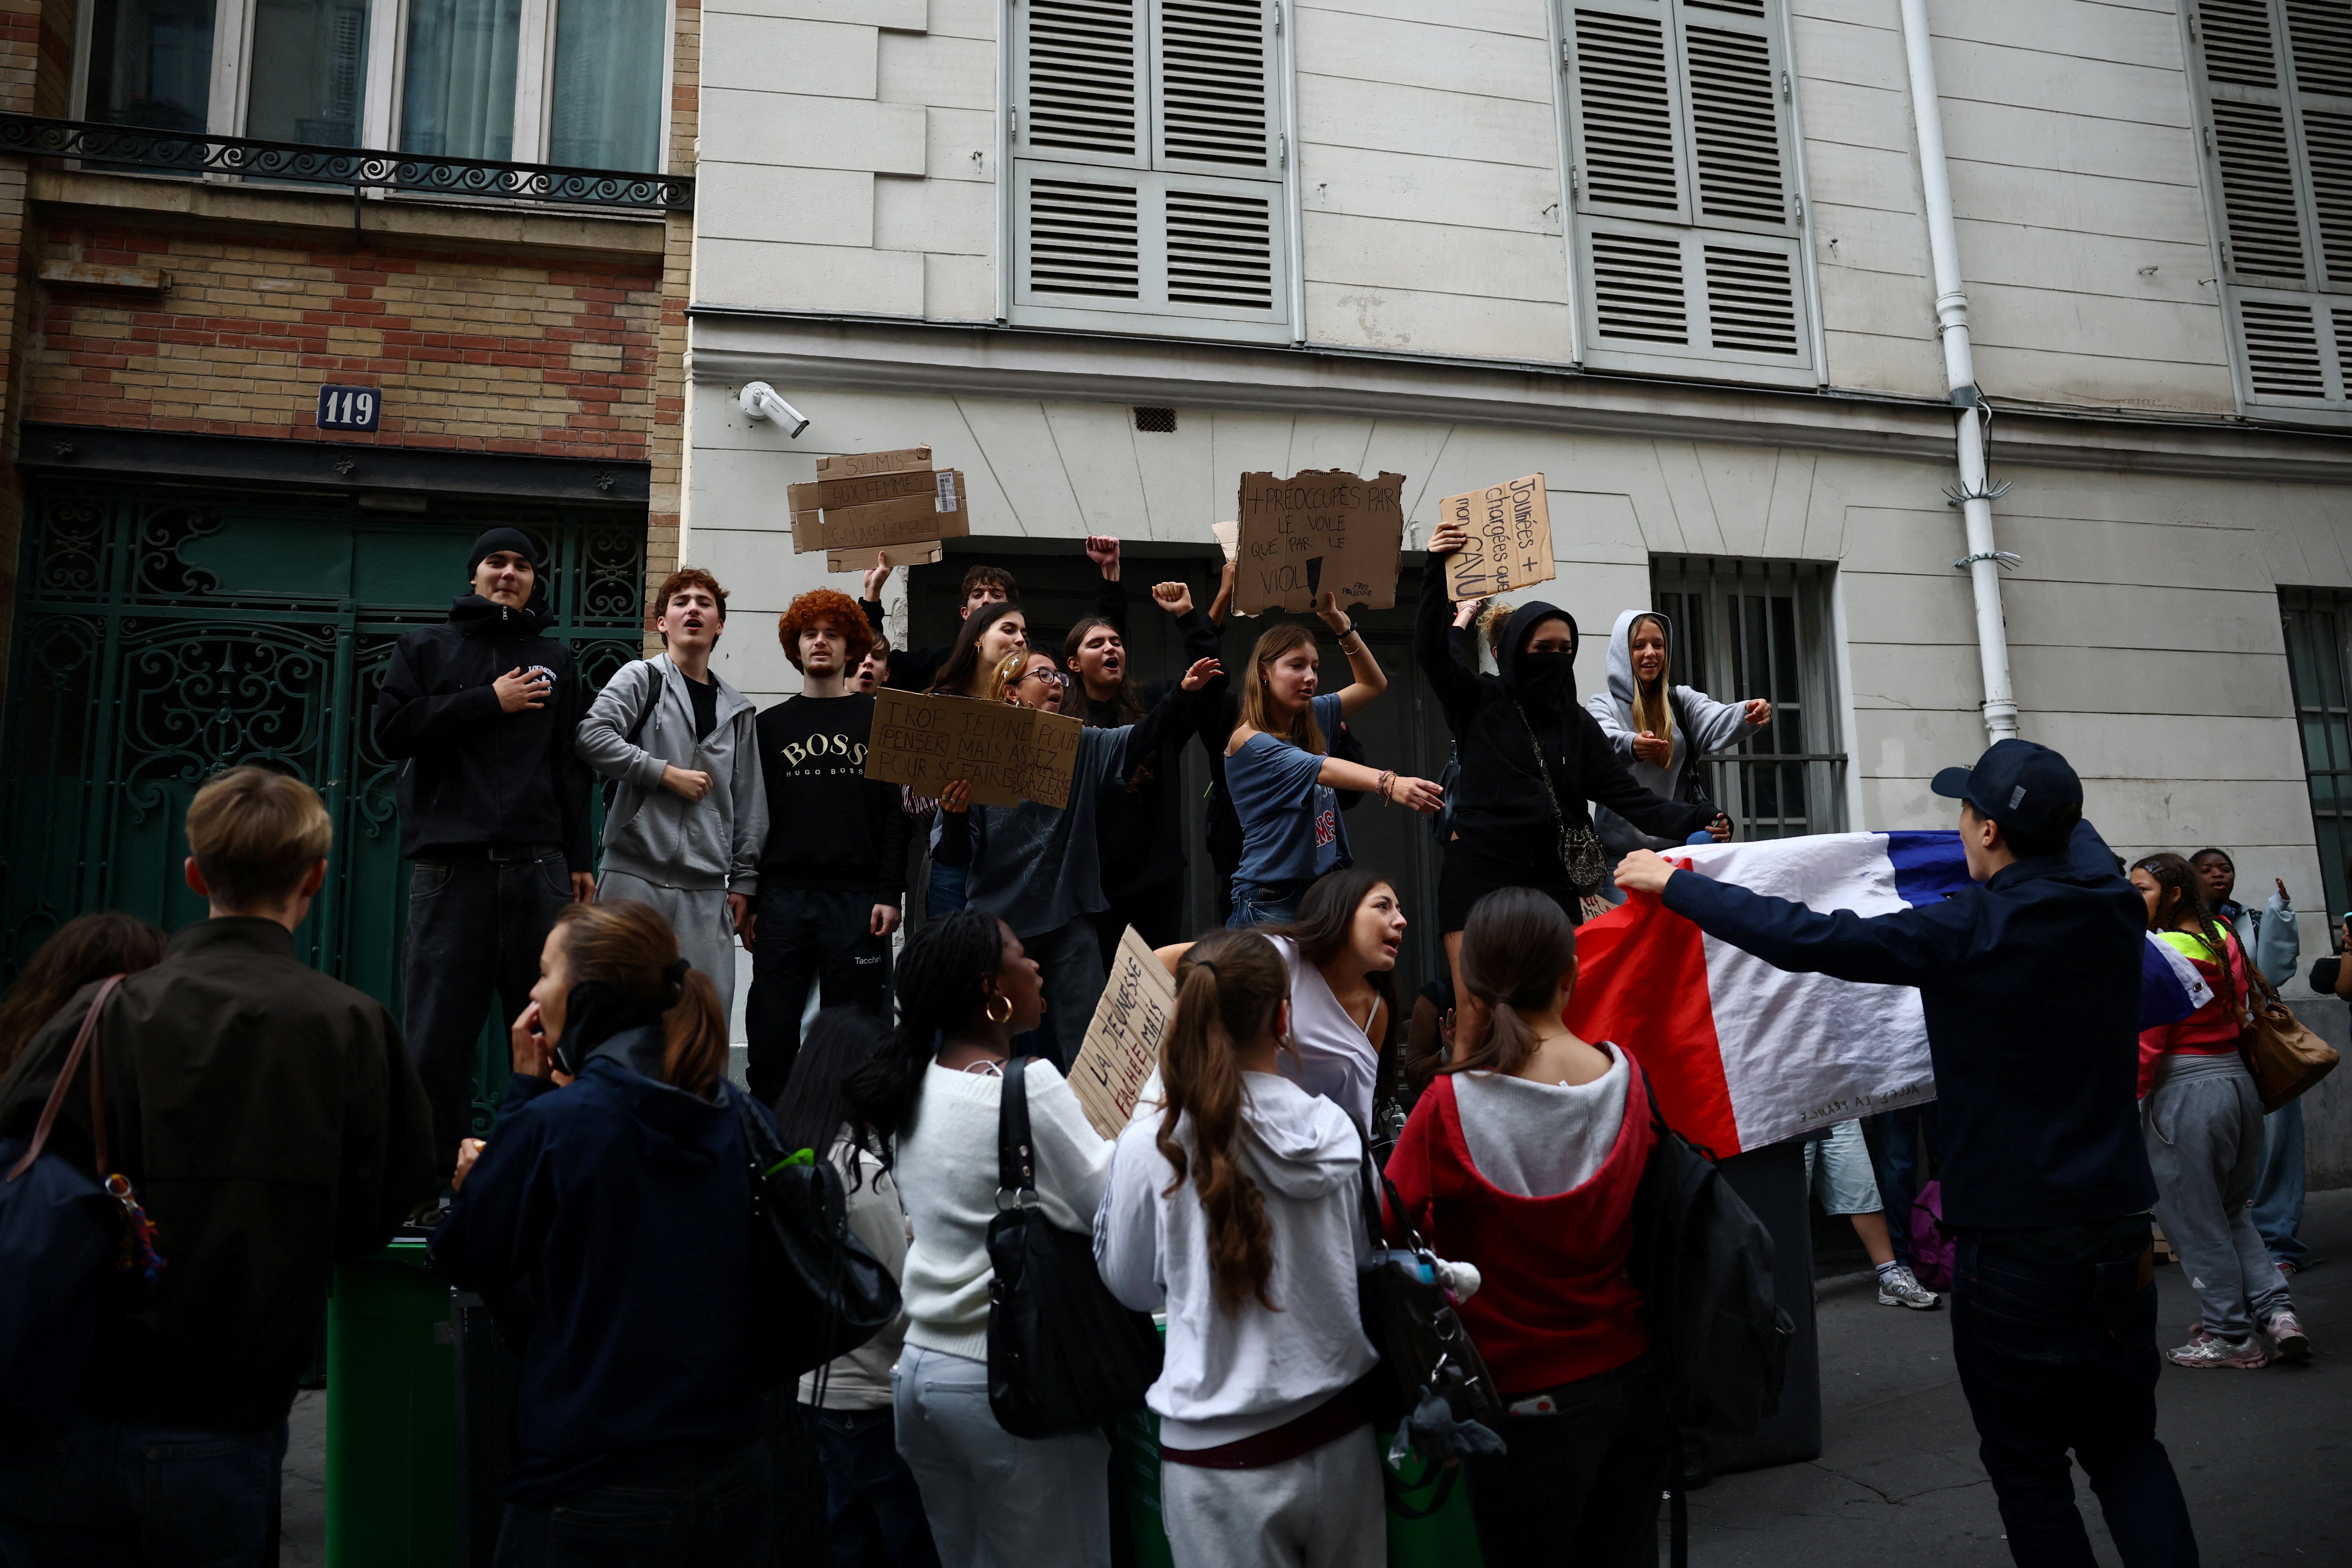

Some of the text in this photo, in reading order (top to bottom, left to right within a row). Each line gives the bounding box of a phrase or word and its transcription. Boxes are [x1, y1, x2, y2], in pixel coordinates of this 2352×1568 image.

[325, 391, 373, 425] 119
[845, 454, 904, 476] SOUMIS
[834, 485, 860, 505] AUX
[865, 475, 923, 498] FEMMES
[1368, 488, 1398, 512] PAR
[848, 504, 896, 524] PAS AU
[1278, 515, 1346, 534] LE VOILE
[1455, 498, 1470, 526] mon
[1251, 537, 1345, 561] QUE PAR LE
[1483, 487, 1511, 592] chargées que
[1353, 582, 1369, 590] FREE
[885, 701, 1080, 751] TROP JEUNE POUR
[781, 733, 868, 767] BOSS
[883, 729, 1058, 770] PENSER MAIS ASSEZ
[786, 769, 820, 777] HUGO
[879, 751, 1064, 796] POUR SE FAIRE GAZER
[854, 955, 881, 964] Tacchini
[1090, 957, 1141, 1087] LA JEUNESSE
